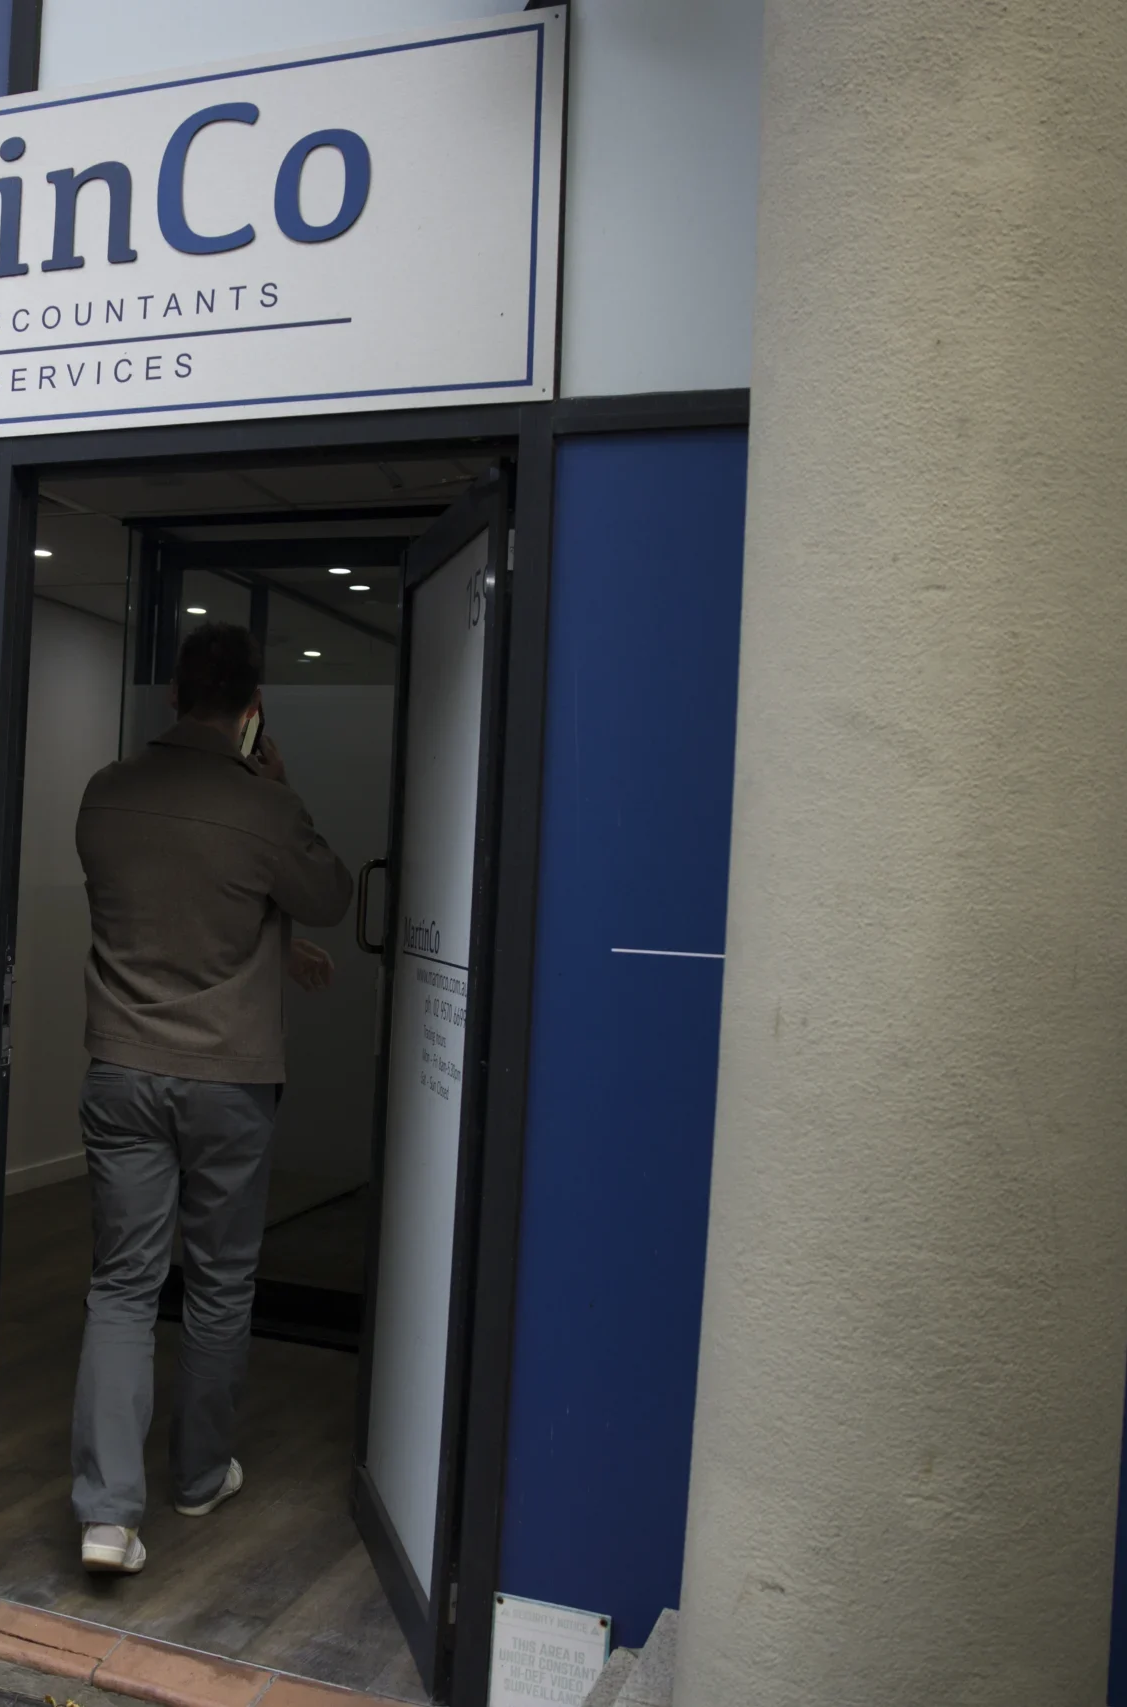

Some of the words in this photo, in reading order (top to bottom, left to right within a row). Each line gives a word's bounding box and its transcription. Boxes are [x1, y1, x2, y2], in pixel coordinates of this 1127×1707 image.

[403, 916, 441, 955] MartinCo
[511, 1608, 555, 1626] SECURITY
[557, 1616, 589, 1634] NOTICE
[499, 1648, 535, 1667] UNDER
[538, 1654, 597, 1681] CONSTANT
[512, 1637, 536, 1653] THIS
[539, 1643, 571, 1661] AREA
[574, 1651, 585, 1665] IS
[510, 1665, 548, 1684] HI-DEF
[550, 1674, 583, 1692] VIDEO
